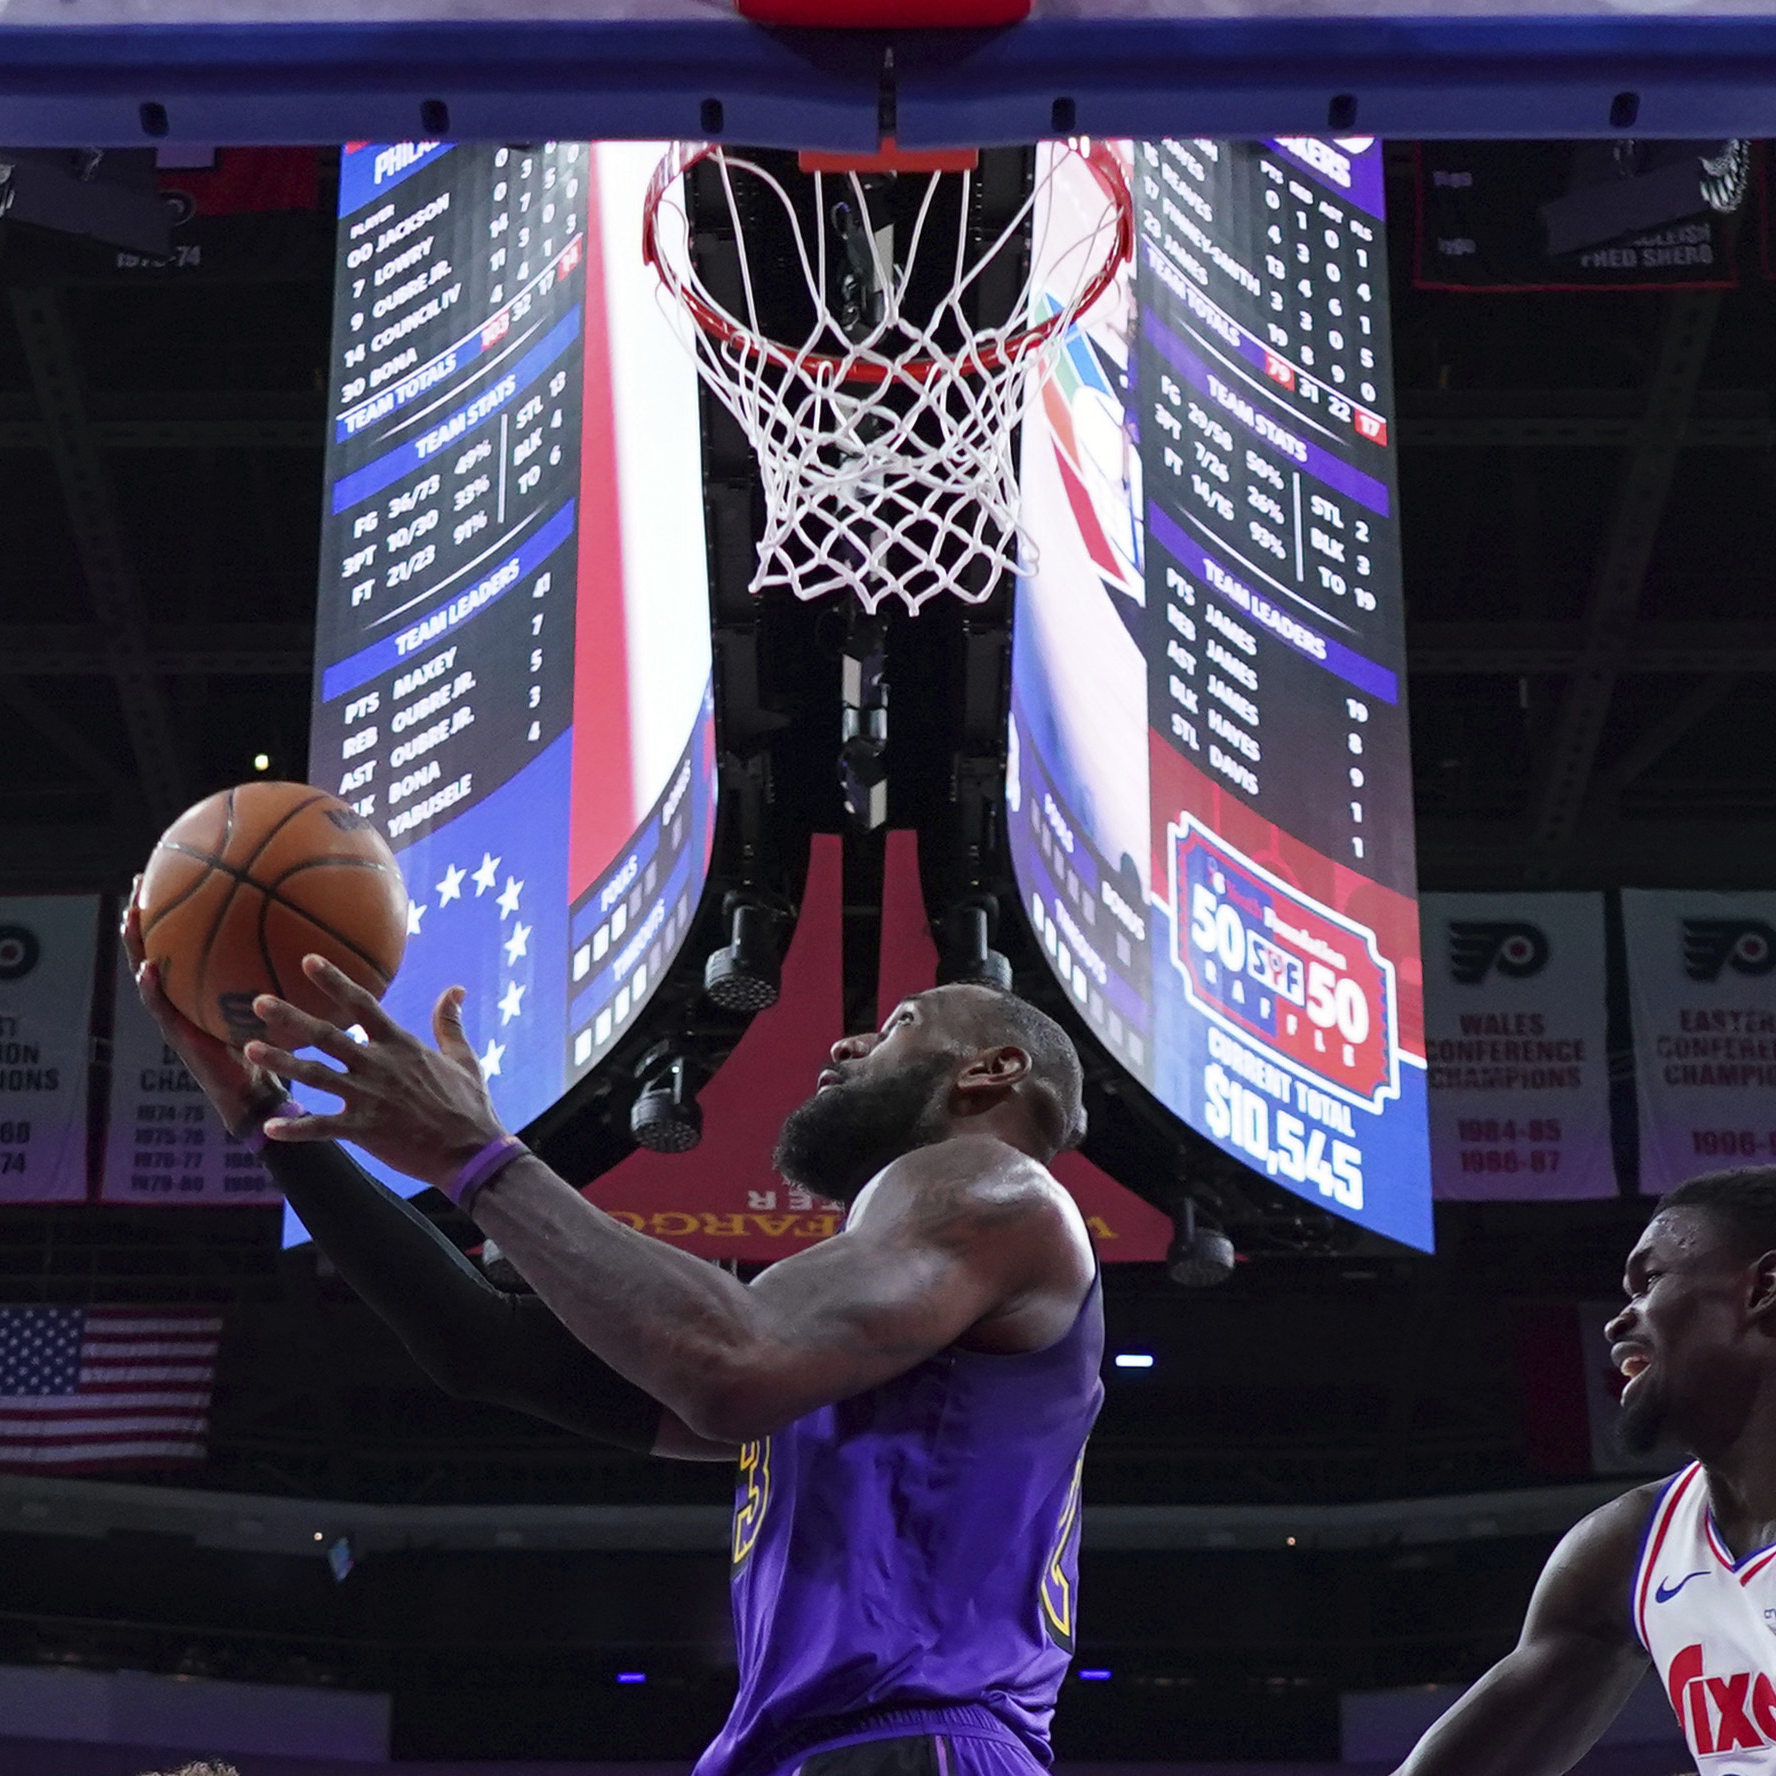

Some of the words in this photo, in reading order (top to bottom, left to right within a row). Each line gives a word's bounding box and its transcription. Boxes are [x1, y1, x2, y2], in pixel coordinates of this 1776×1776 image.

[375, 191, 450, 253] JACKSON
[344, 392, 395, 433] TEAM
[394, 352, 458, 404] TOTALS
[415, 411, 467, 459] TEAM
[466, 373, 517, 426] STATS
[1206, 373, 1255, 428] TEAM
[1254, 413, 1309, 463] STATS
[351, 577, 376, 608] FT
[394, 610, 448, 656] TEAM
[447, 557, 521, 625] LEADERS
[1202, 557, 1252, 612] TEAM
[1250, 594, 1327, 661] LEADERS
[1317, 564, 1348, 596] TO
[344, 691, 381, 725] PTS
[392, 645, 458, 701] MAXEY
[338, 759, 378, 796] AST
[387, 760, 442, 805] BONA
[1191, 882, 1246, 973] 50
[1305, 960, 1370, 1045] 50
[1425, 1039, 1585, 1063] CONFERENCE
[1459, 1014, 1545, 1037] WALES
[1206, 1026, 1292, 1104] CURRENT
[1295, 1079, 1357, 1139] TOTAL
[1427, 1065, 1582, 1090] CHAMPIONS
[1203, 1060, 1365, 1211] $10,545
